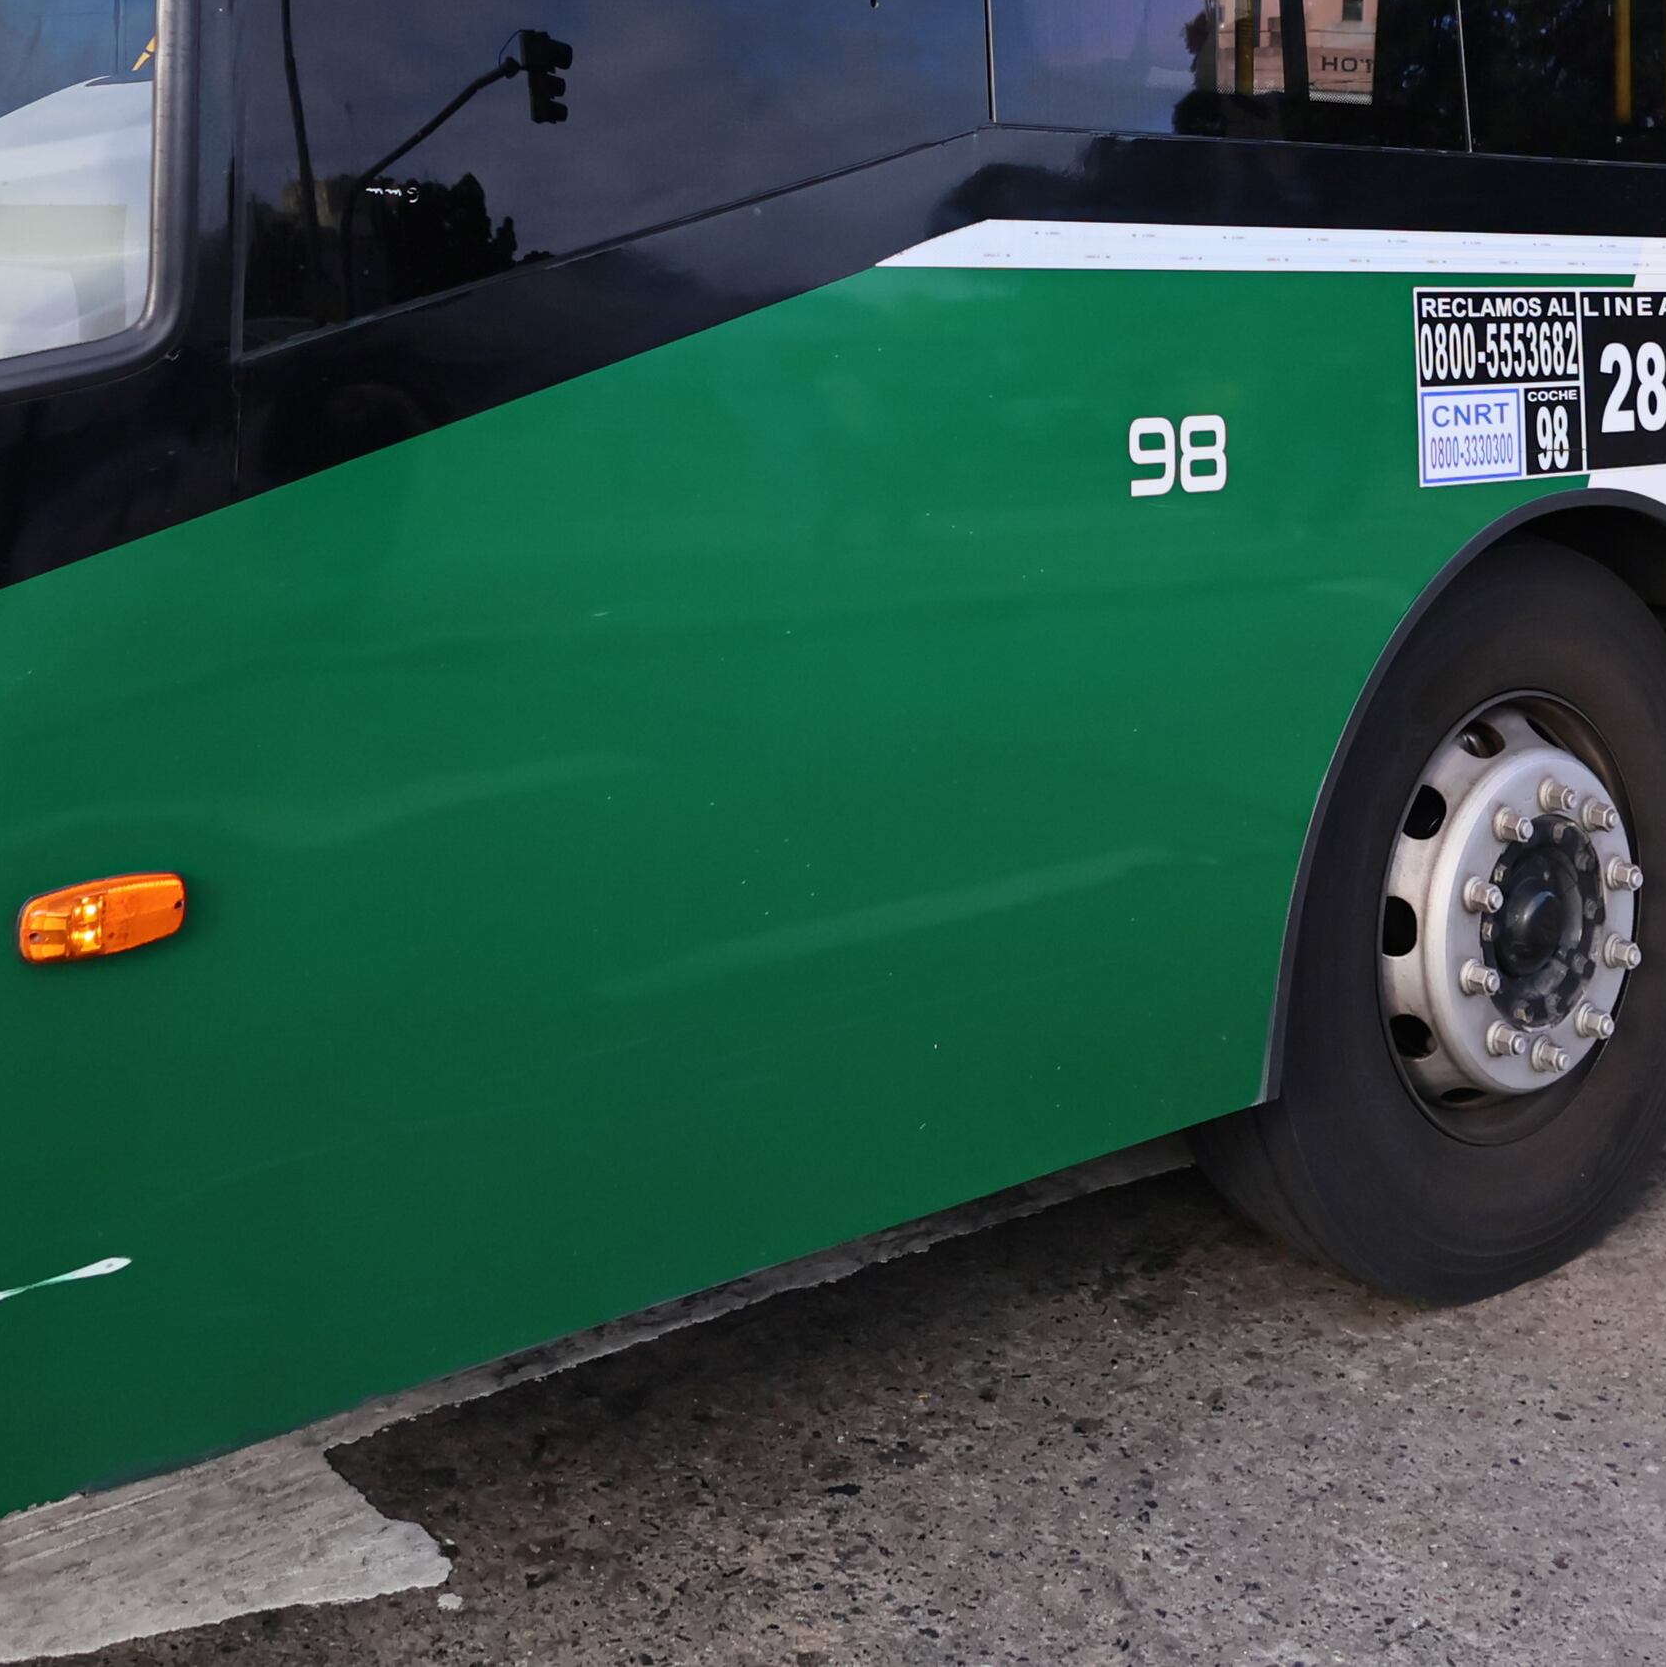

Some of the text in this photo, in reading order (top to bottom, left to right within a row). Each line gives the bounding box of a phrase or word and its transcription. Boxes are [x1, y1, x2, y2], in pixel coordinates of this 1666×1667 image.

[1421, 297, 1575, 318] RECLAMOS AL
[1420, 321, 1579, 381] 0800-5553682
[1527, 389, 1579, 403] COCHE
[1432, 403, 1509, 427] CNRT
[1129, 414, 1227, 497] 98
[1430, 433, 1513, 469] 0800-3330300
[1536, 405, 1570, 471] 98
